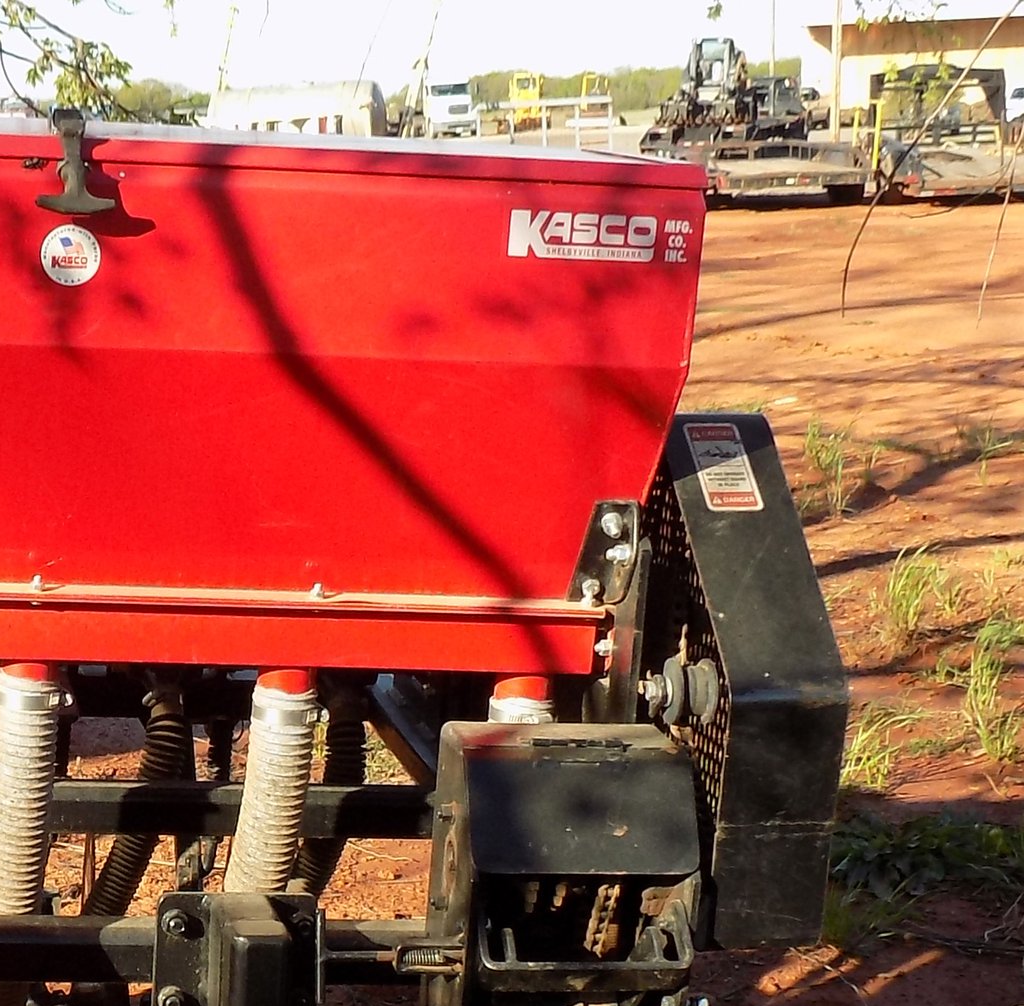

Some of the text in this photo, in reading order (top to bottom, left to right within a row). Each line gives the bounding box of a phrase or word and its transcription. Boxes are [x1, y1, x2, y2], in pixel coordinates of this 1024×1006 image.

[507, 209, 657, 258] KASCO
[664, 219, 694, 234] MFG.
[668, 235, 687, 249] CO.
[545, 247, 643, 259] SHELBYVILLE INDIANA
[664, 249, 687, 263] INC.
[51, 255, 88, 269] KASCO
